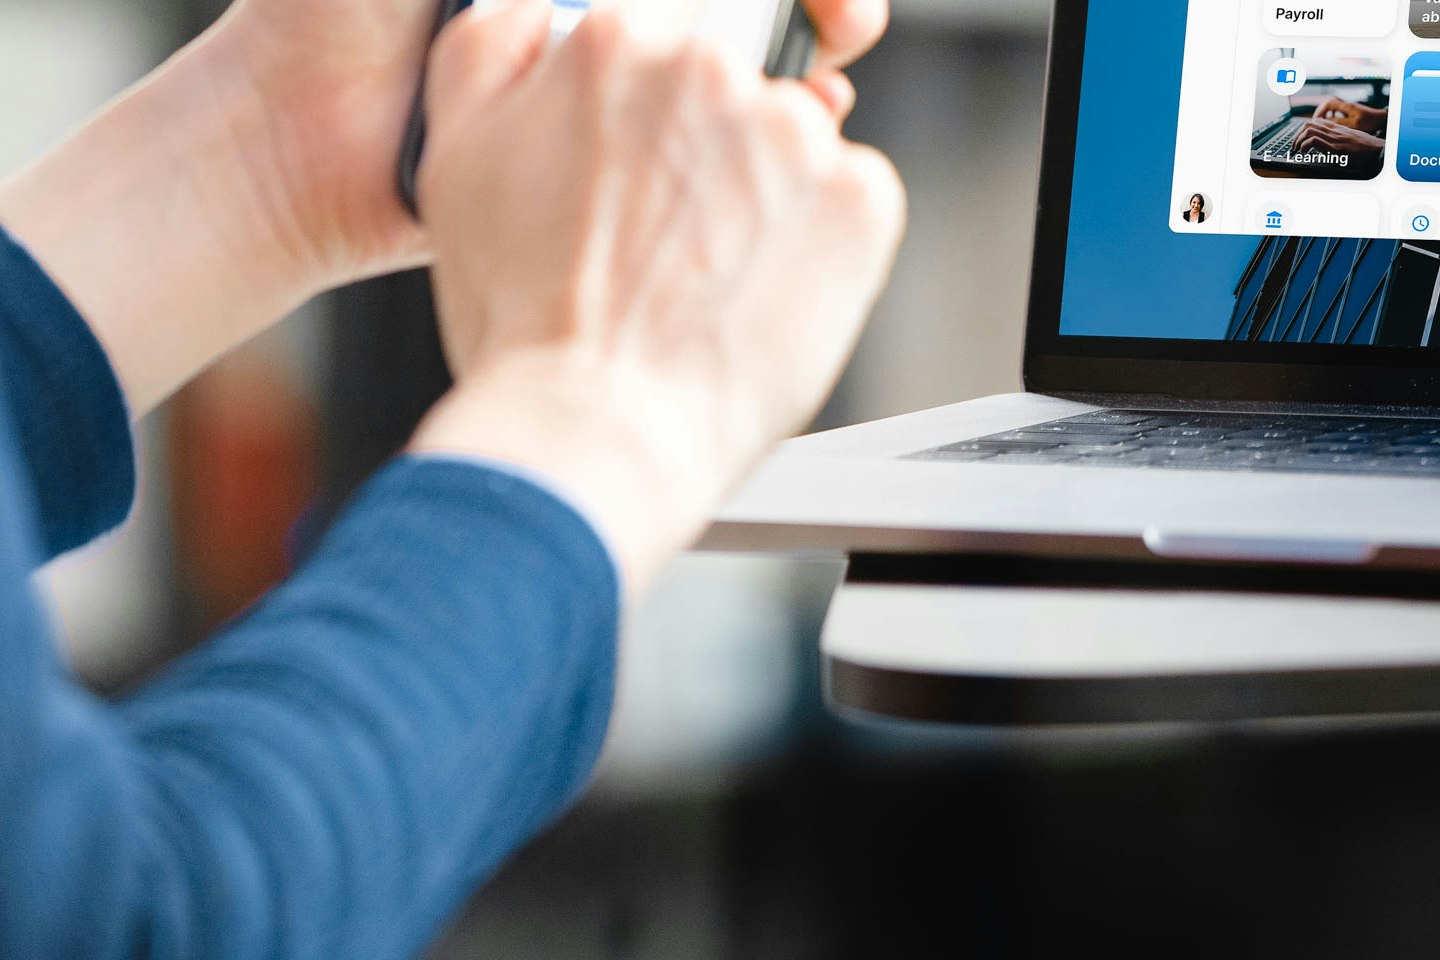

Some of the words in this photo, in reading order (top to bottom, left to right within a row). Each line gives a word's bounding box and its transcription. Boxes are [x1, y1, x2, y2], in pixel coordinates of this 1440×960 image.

[1276, 8, 1323, 22] Payroll
[1263, 150, 1272, 163] E
[1286, 151, 1349, 167] Learning
